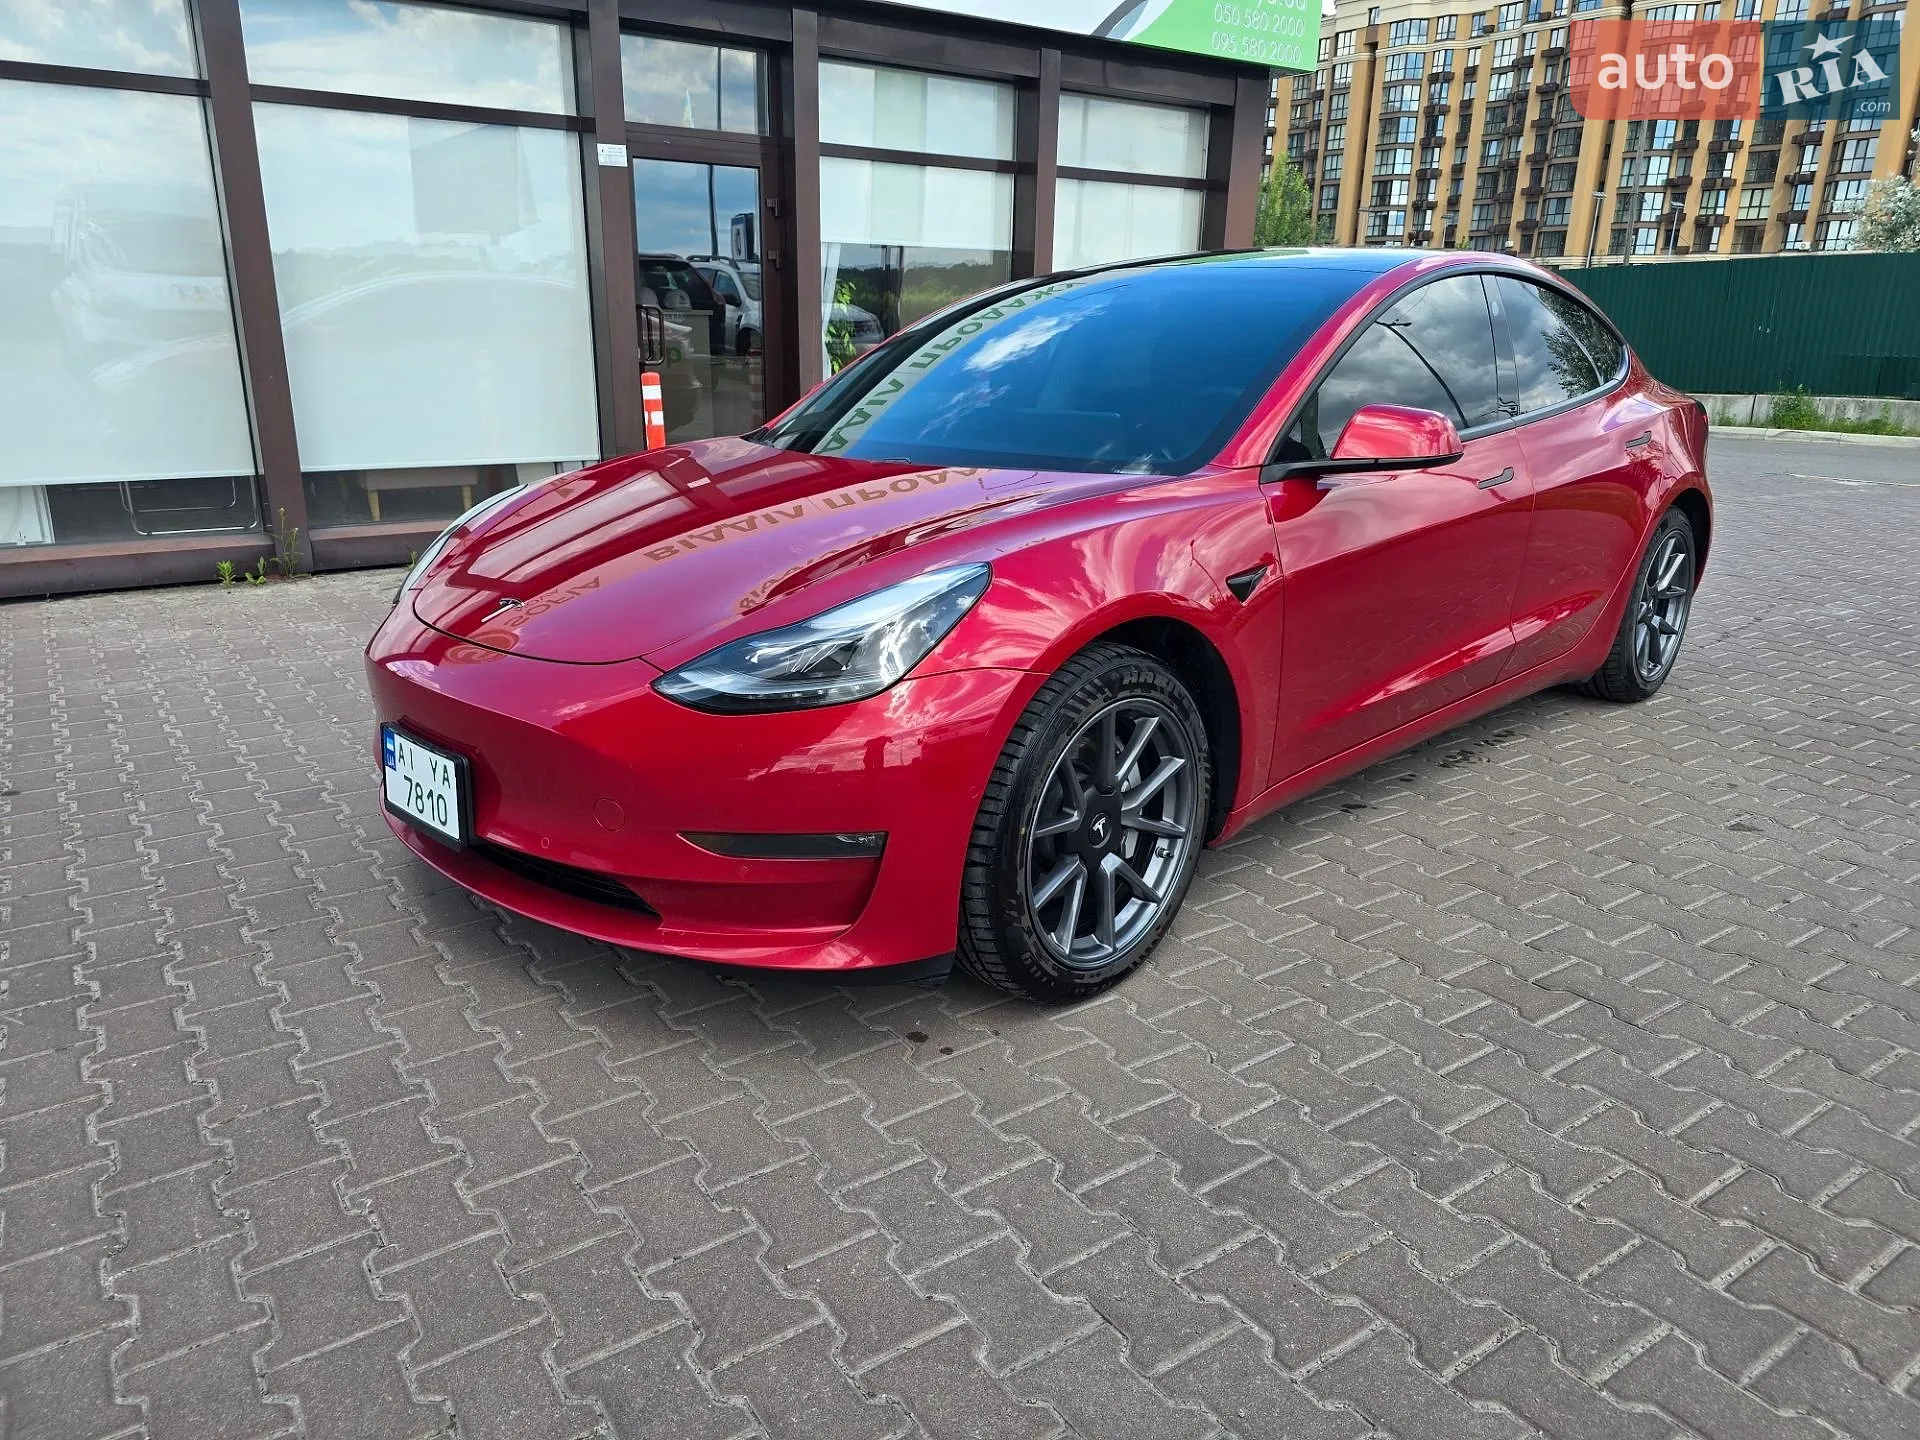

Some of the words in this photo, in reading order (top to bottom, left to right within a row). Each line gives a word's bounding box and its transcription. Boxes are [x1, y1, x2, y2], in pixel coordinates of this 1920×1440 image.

[1214, 2, 1240, 26] 050
[1243, 9, 1269, 31] 580
[1272, 14, 1304, 37] 2000
[1211, 31, 1237, 54] 095
[1240, 37, 1266, 58] 580
[1269, 41, 1301, 64] 2000
[429, 757, 451, 789] YA
[404, 775, 447, 826] 7810
